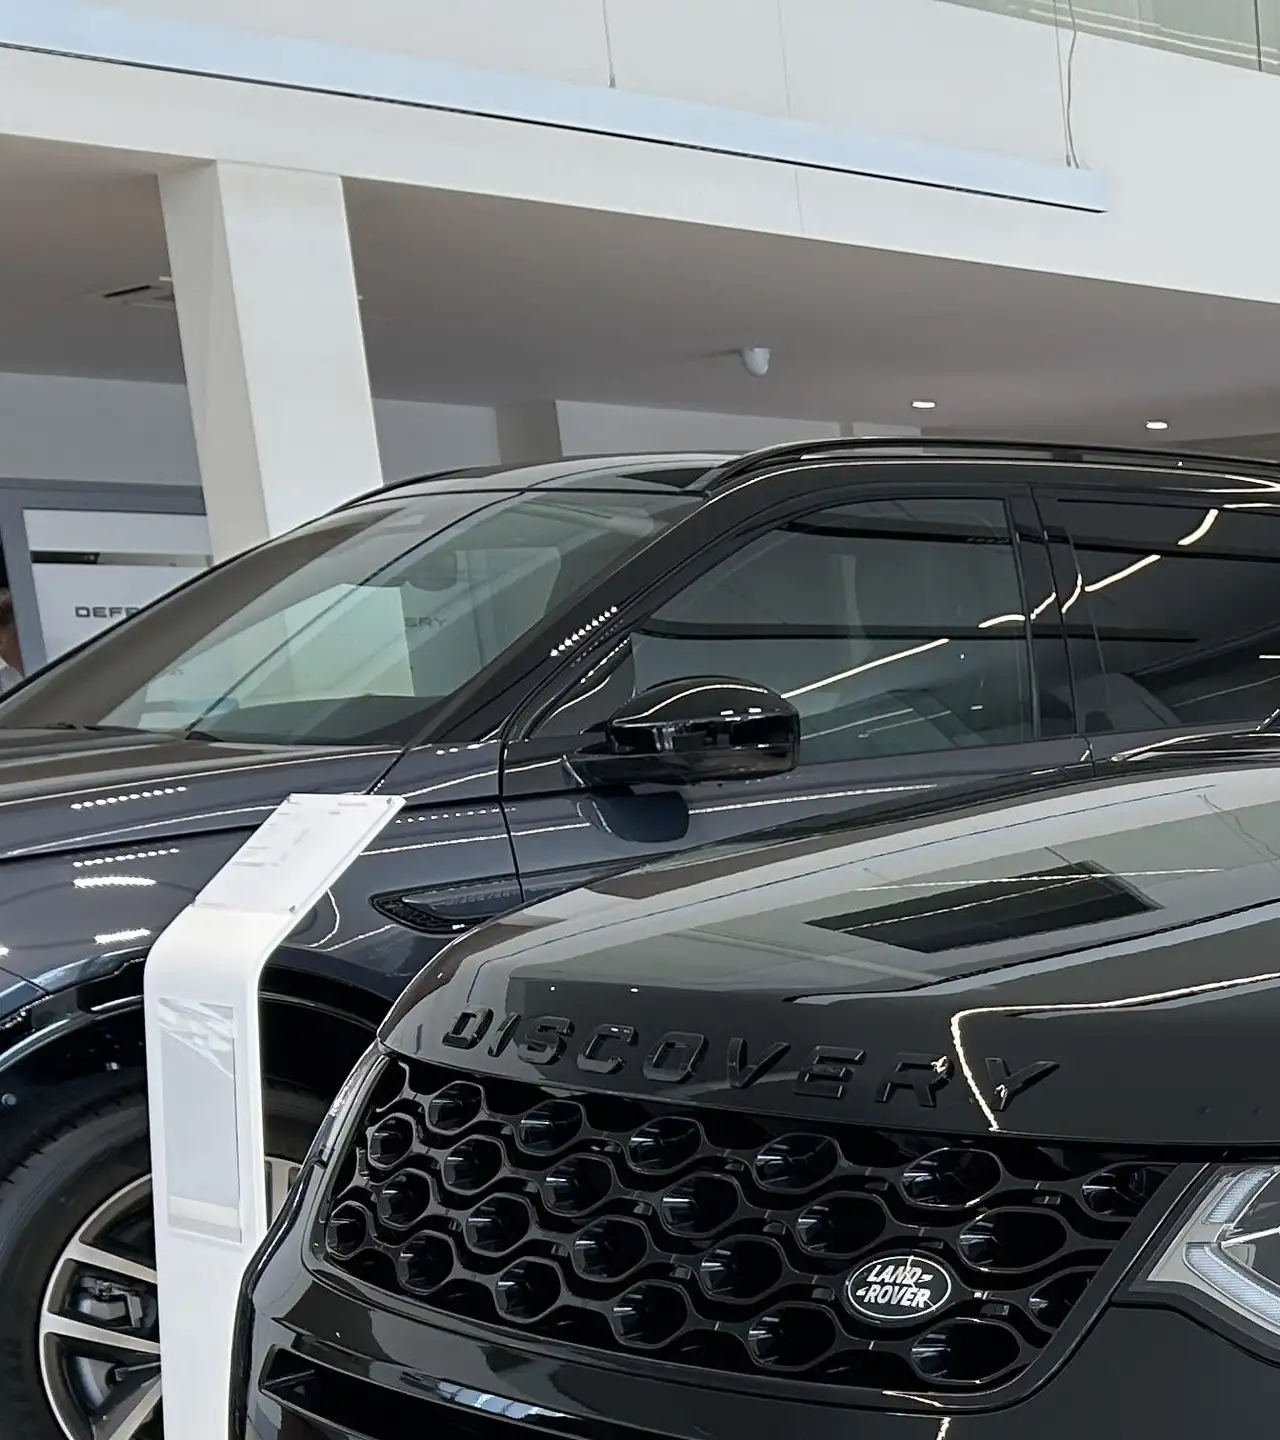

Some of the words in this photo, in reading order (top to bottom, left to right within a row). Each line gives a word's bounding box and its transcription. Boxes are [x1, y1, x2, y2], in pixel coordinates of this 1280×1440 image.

[443, 1005, 1060, 1111] DISCOVERY
[866, 1264, 922, 1285] LAND
[863, 1284, 931, 1308] ROVER
